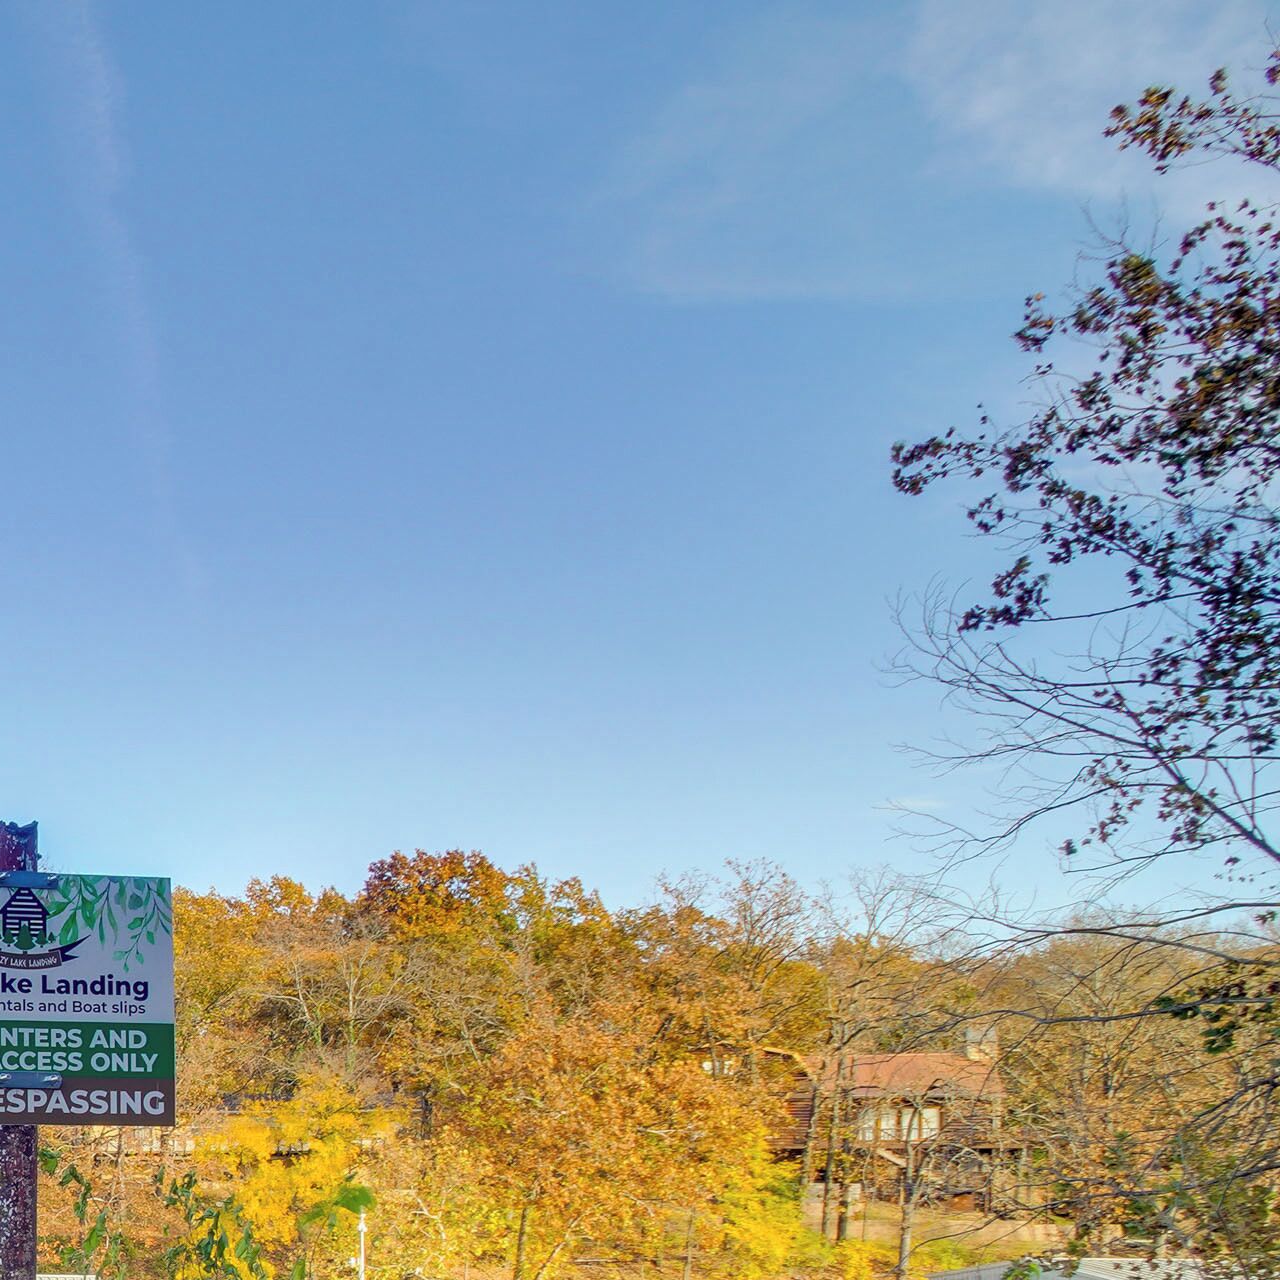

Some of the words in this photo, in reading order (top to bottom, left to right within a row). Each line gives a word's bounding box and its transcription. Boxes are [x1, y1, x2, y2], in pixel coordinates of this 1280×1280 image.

[10, 957, 27, 967] LAKE
[28, 955, 58, 967] LANDING
[41, 974, 149, 1001] Landing
[38, 999, 67, 1013] and
[72, 1000, 109, 1014] Boat
[111, 1000, 146, 1016] slips
[89, 1029, 147, 1049] AND
[90, 1052, 159, 1073] ONLY
